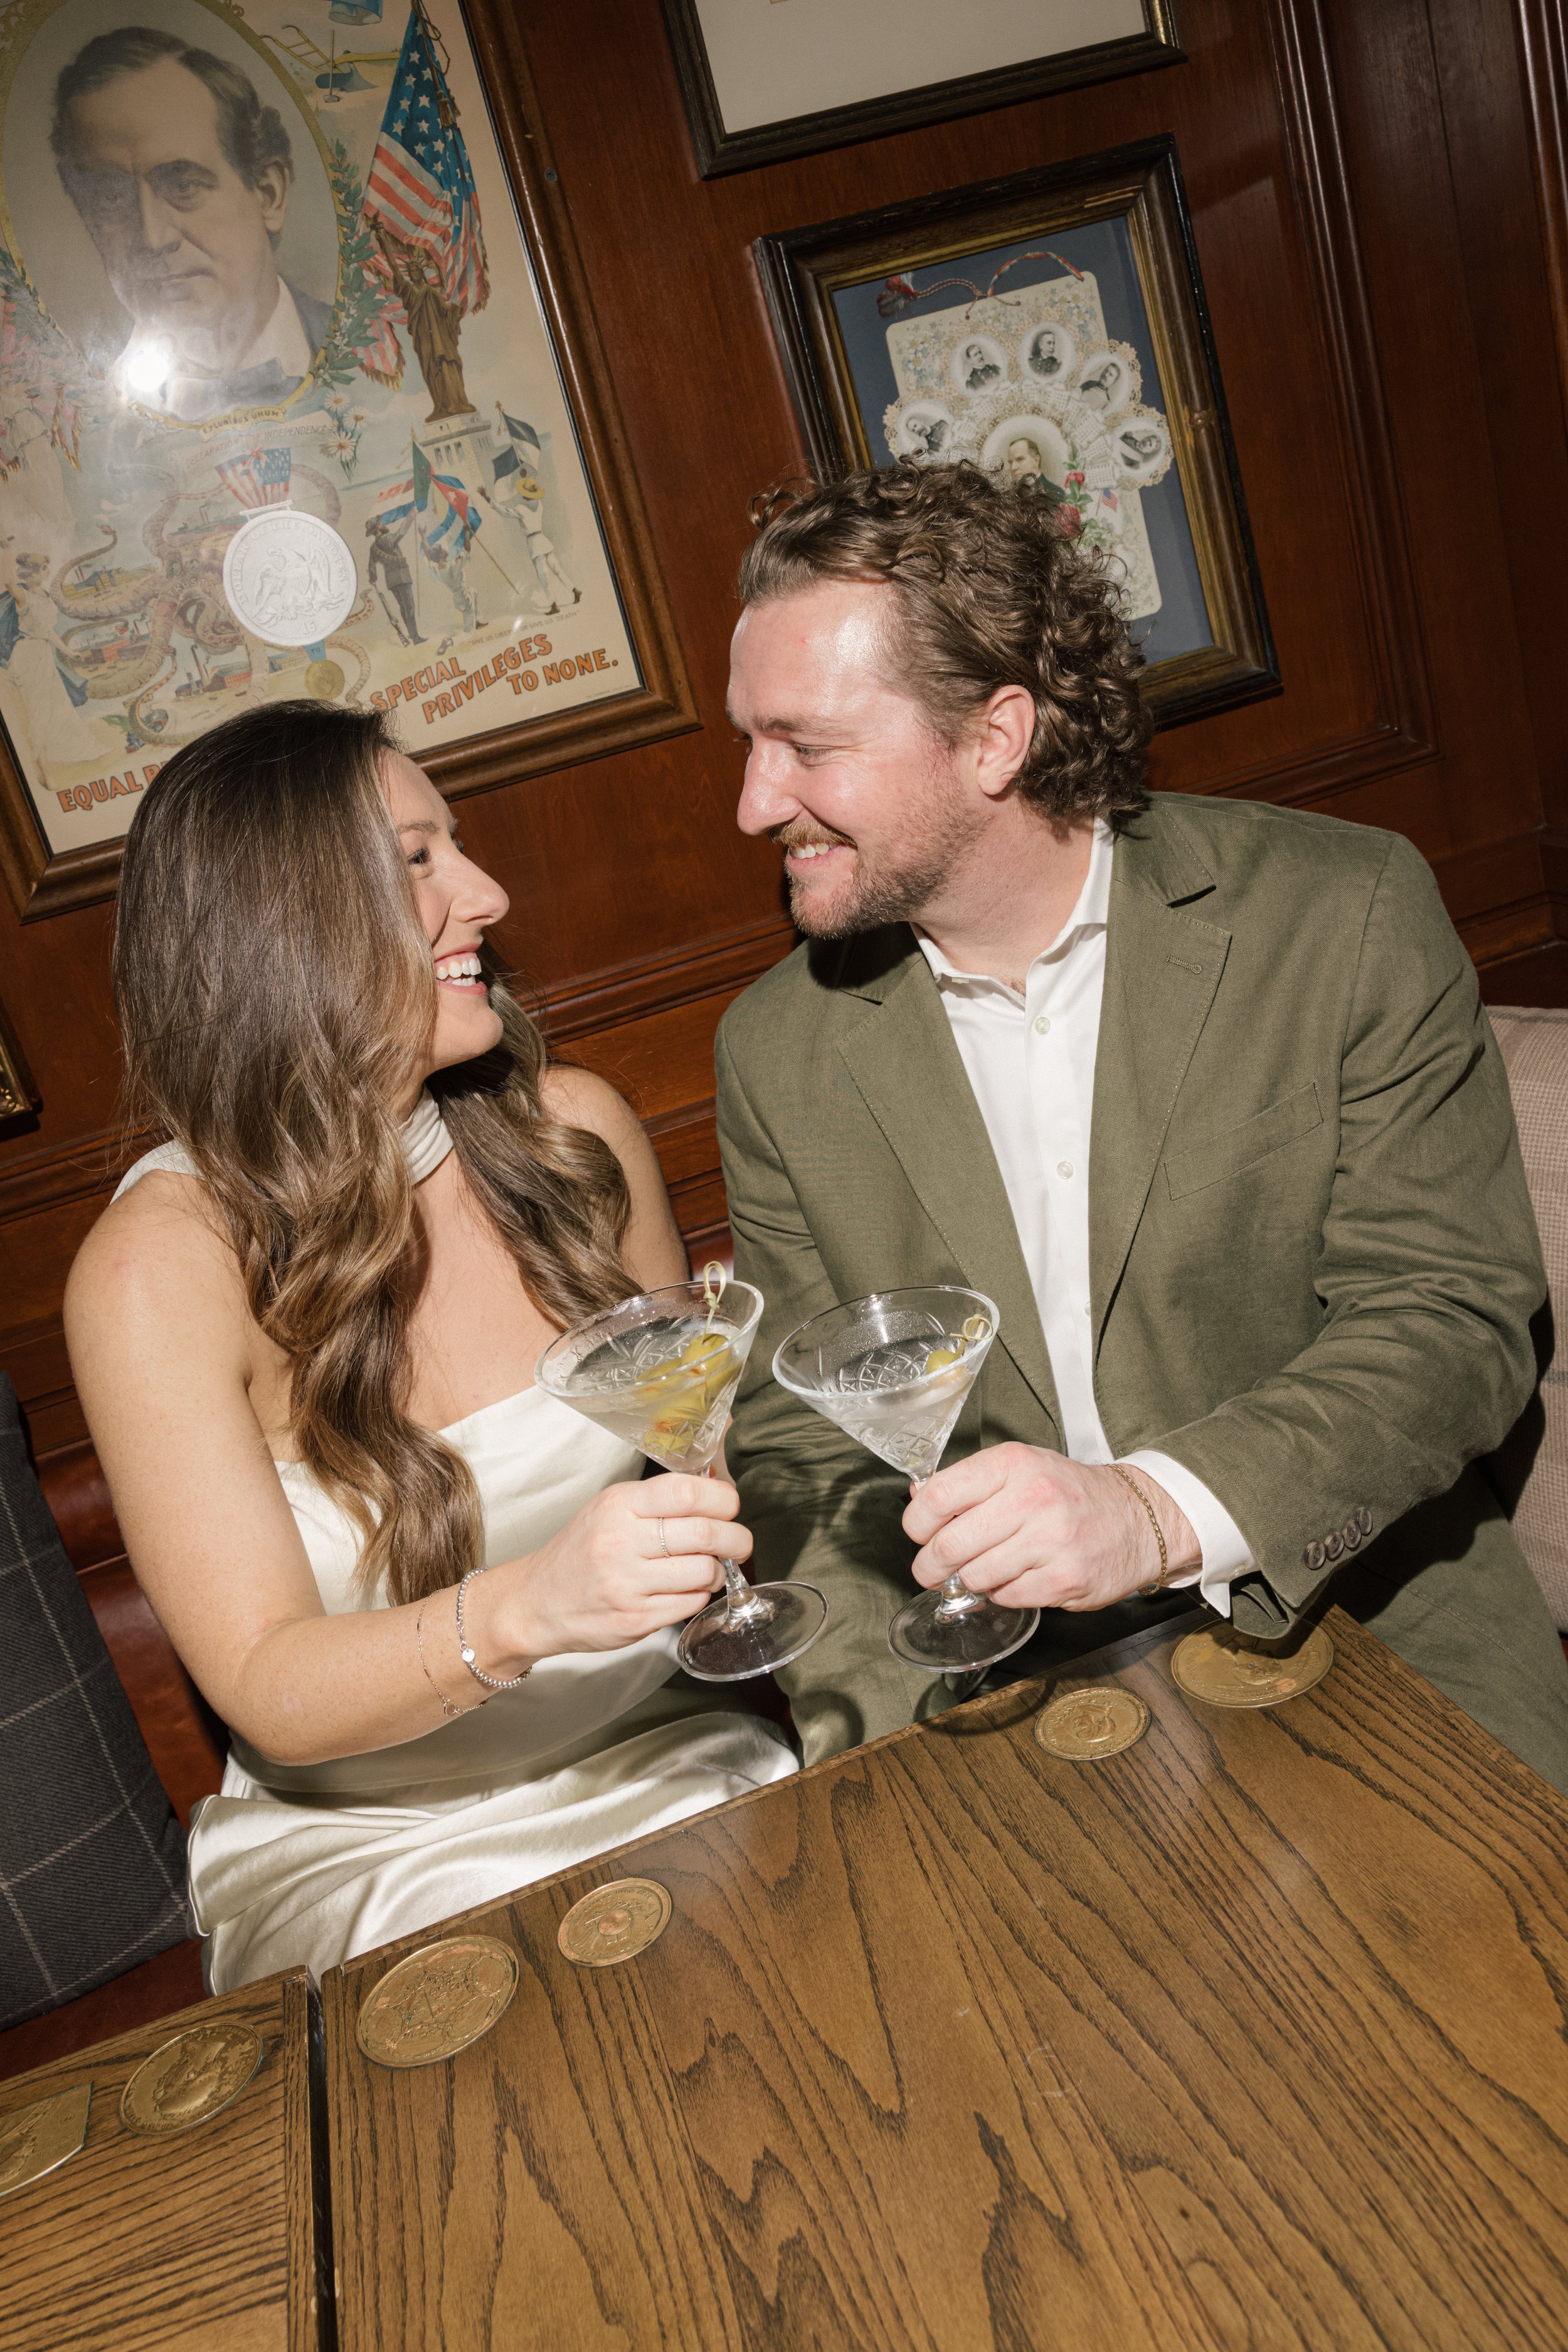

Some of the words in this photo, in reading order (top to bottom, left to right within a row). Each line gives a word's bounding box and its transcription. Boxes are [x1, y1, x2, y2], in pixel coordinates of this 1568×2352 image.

[209, 416, 249, 431] PLURIBUS
[252, 410, 279, 420] UNUM
[186, 439, 239, 469] DECLARATION
[264, 425, 327, 440] INDEPENDENCE
[166, 578, 216, 596] TRUSTS
[232, 545, 250, 604] DOLLAR
[494, 629, 514, 639] LIBER
[529, 620, 544, 629] GIVE
[370, 657, 467, 712] SPECIAL
[421, 633, 553, 725] PRIVILEGES
[506, 669, 539, 695] TO
[542, 647, 618, 686] NONE.
[56, 770, 144, 813] EQUAL
